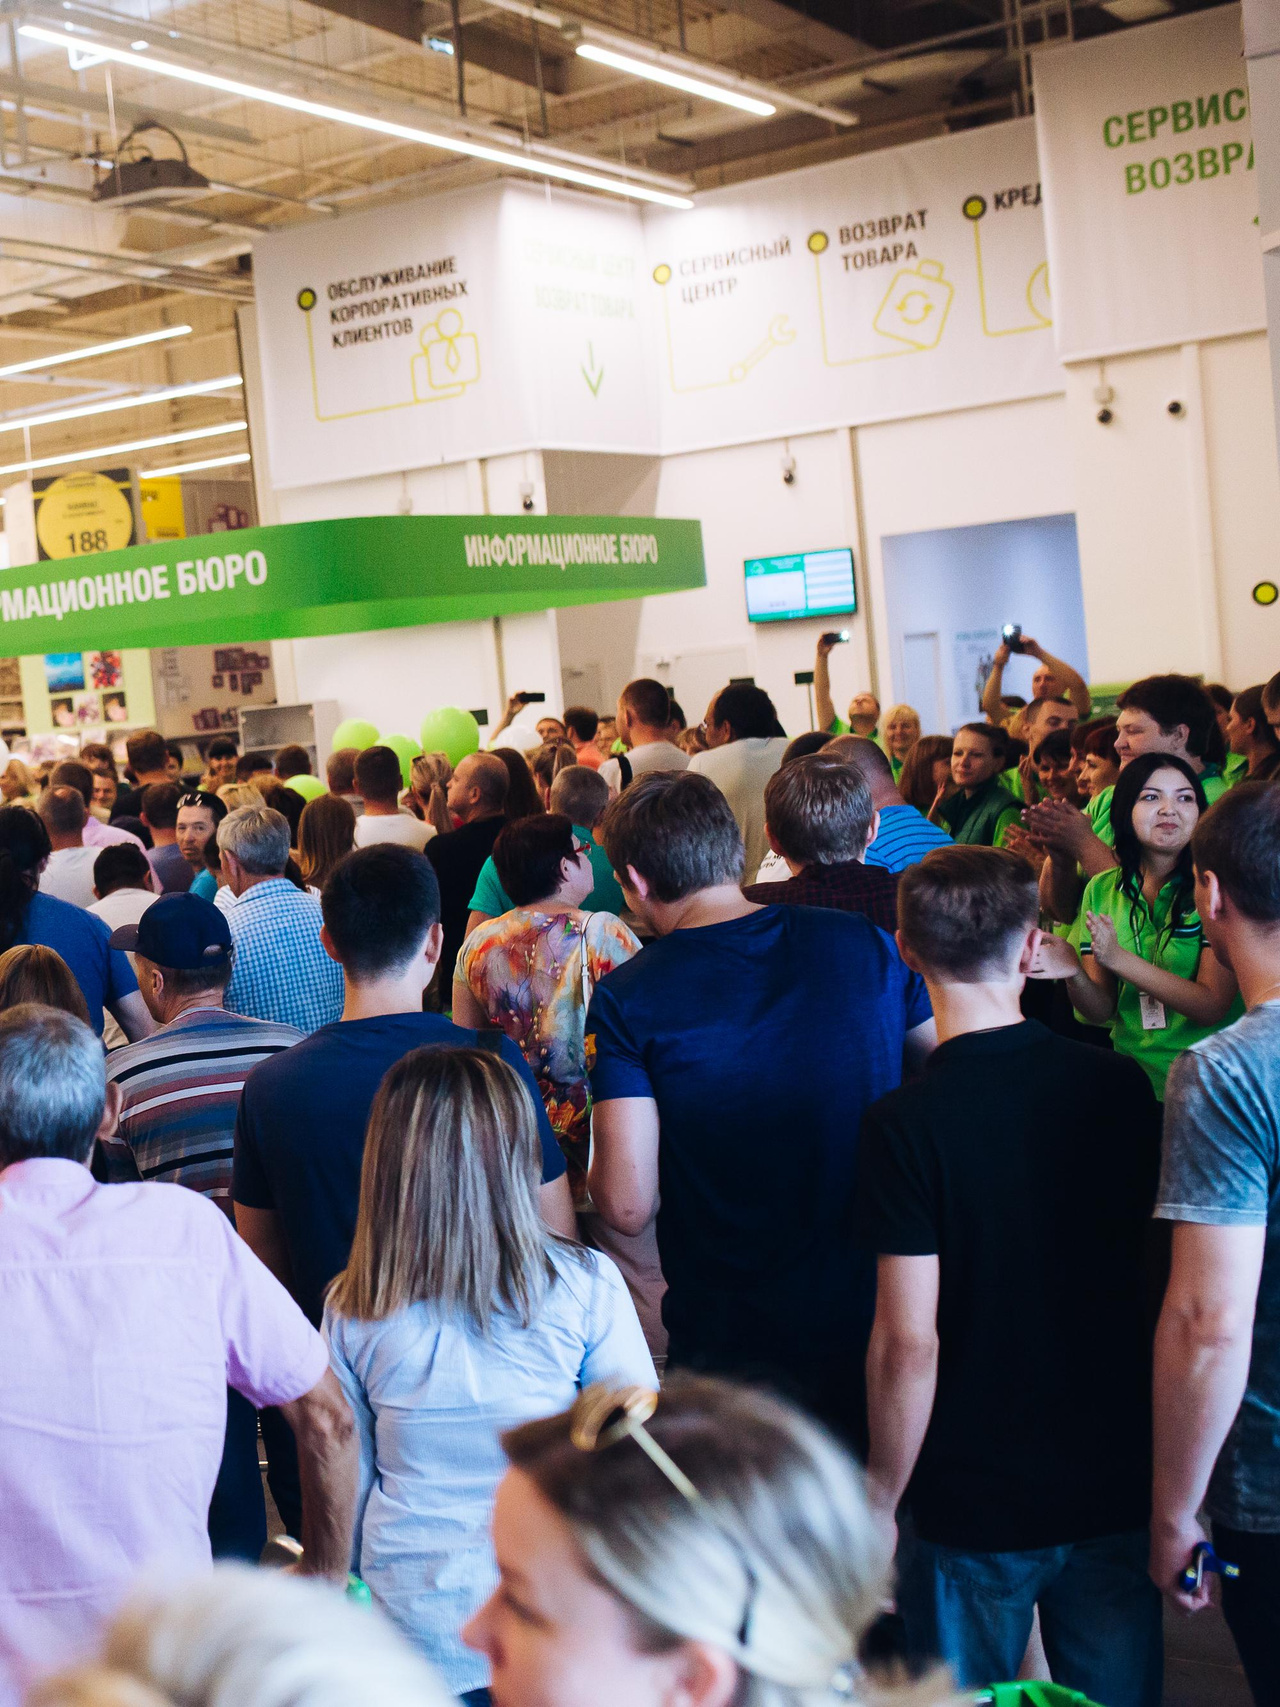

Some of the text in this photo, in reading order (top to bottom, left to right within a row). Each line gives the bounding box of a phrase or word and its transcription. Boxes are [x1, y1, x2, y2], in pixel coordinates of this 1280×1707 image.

[1102, 87, 1247, 148] СЕРВИС
[838, 208, 928, 245] ВОЗВРАТ
[680, 235, 791, 276] СЕРВИСНЫЙ
[841, 241, 918, 272] ТОВАРА
[327, 256, 458, 300] ОБСЛУЖИВАНИЕ
[682, 278, 737, 303] ЦЕНТР
[330, 280, 469, 324] КОРПОРАТИВНЫХ
[332, 318, 414, 348] КЛИЕНТОВ
[68, 529, 108, 552] 188
[464, 534, 659, 571] ИНФОРМАЦИОННОЕ БЮРО
[176, 550, 268, 596] БЮРО
